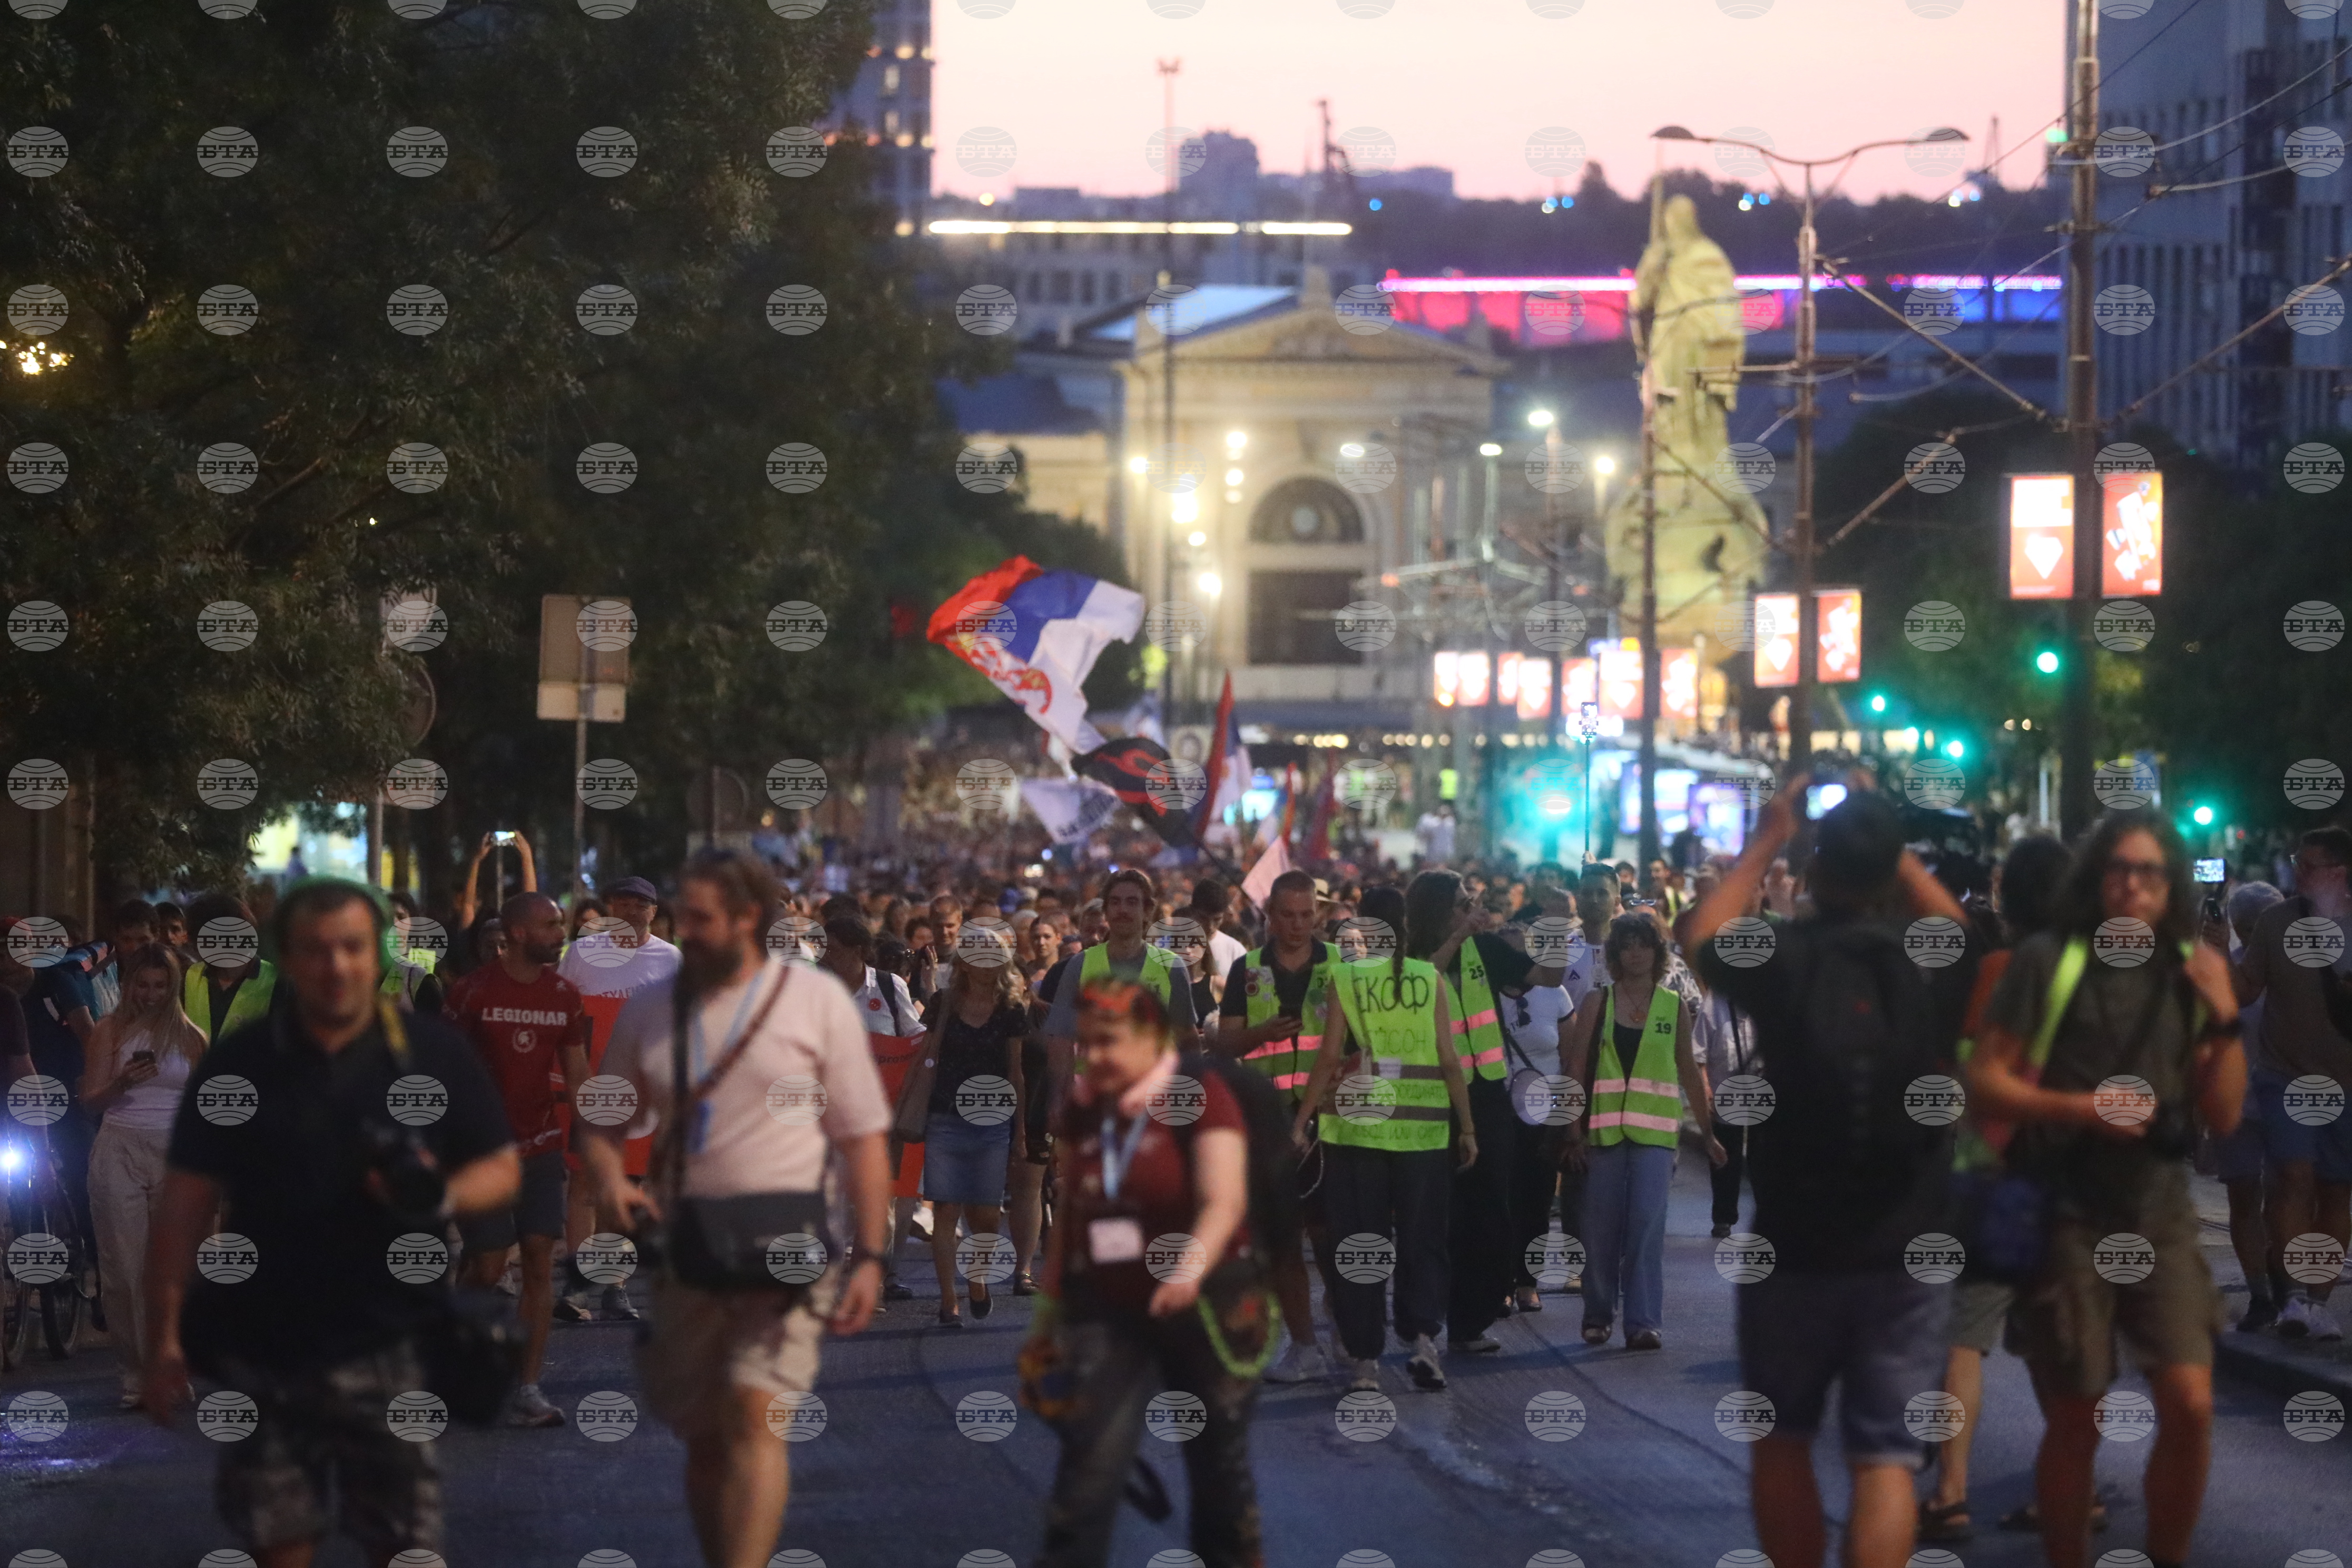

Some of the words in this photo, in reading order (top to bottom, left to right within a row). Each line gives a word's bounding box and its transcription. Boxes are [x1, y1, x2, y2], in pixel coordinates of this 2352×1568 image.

[1469, 965, 1484, 980] 25
[482, 1007, 567, 1026] LEGIONAR
[1655, 1022, 1671, 1034] 19
